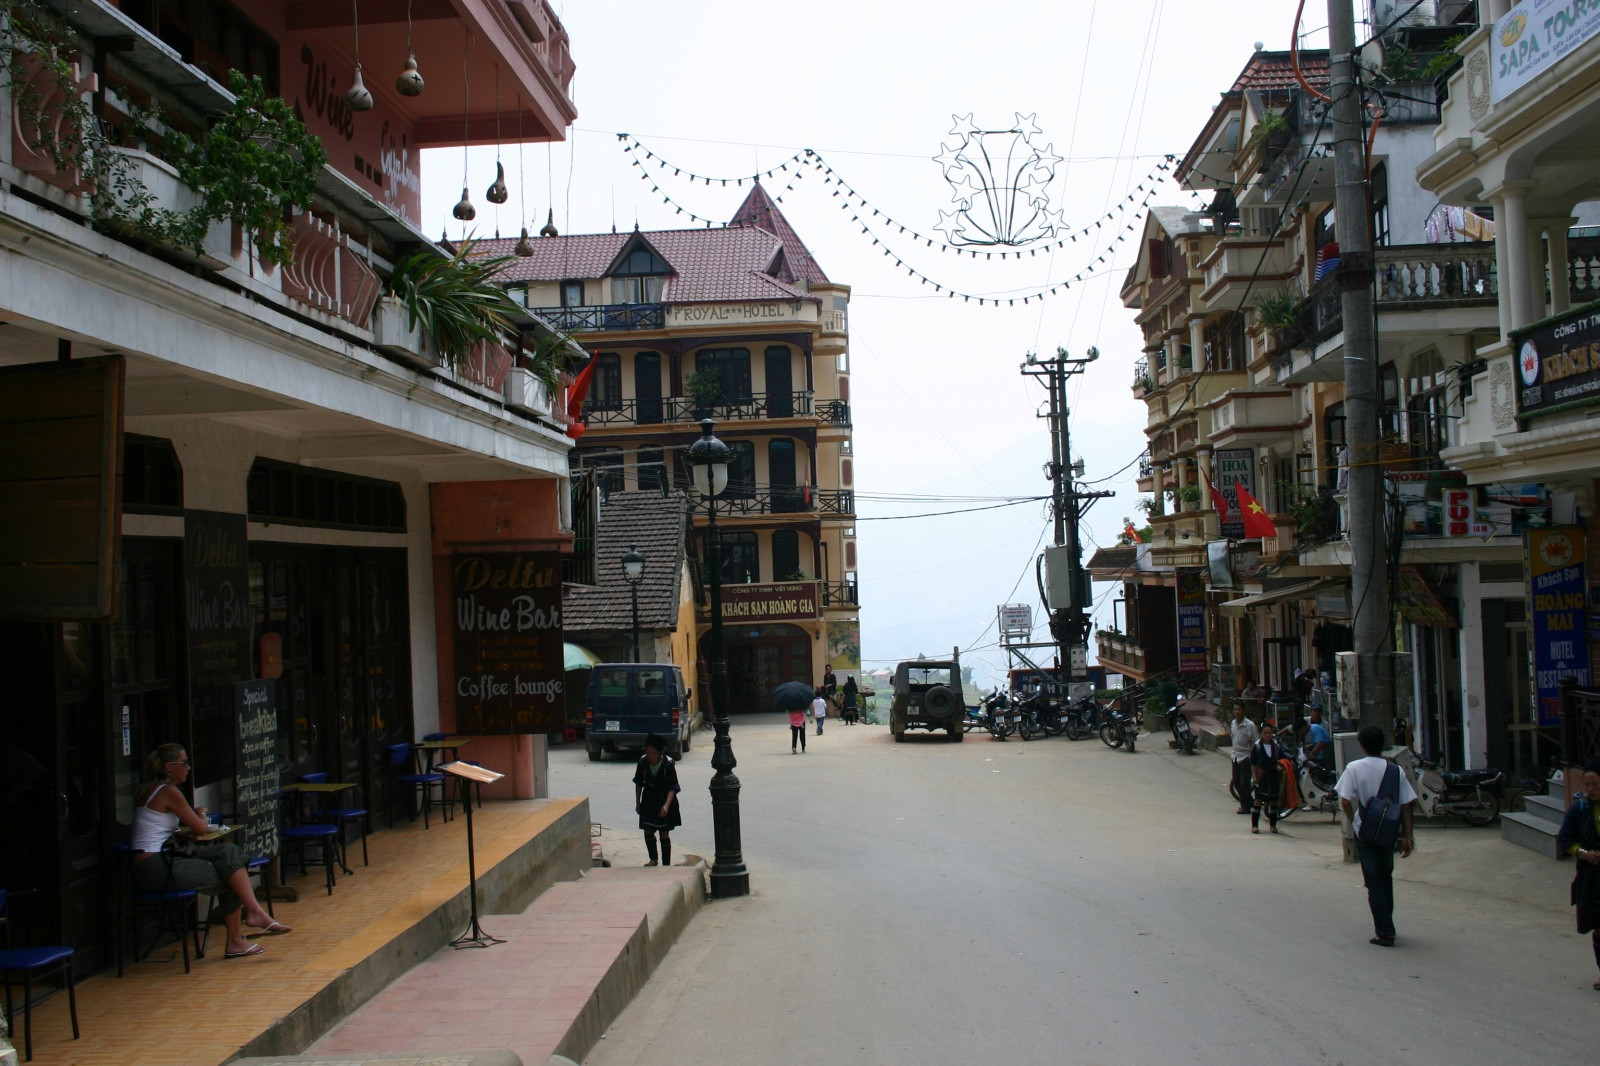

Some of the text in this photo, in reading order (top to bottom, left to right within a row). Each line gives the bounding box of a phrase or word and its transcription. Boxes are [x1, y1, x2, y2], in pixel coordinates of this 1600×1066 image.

[1499, 32, 1540, 79] SAPA
[300, 41, 354, 142] Wine
[684, 303, 784, 321] ROYAL HOTEL
[1554, 323, 1576, 339] CÔNG
[1578, 318, 1588, 331] TY
[1543, 344, 1590, 384] KHÁCH
[1222, 460, 1248, 471] HOA
[1448, 490, 1469, 536] PUB
[190, 524, 239, 568] Delta
[455, 557, 557, 591] Delta
[1537, 571, 1562, 589] Khách
[185, 575, 250, 632] Wine Bar
[721, 595, 815, 618] KHÁCH SẠN HOÀNG GIA
[1535, 588, 1584, 611] HOÀNG
[457, 594, 561, 632] Wine Bar
[1547, 614, 1573, 630] MAI
[1550, 640, 1575, 660] HOTEL
[1556, 661, 1568, 669] &
[243, 687, 268, 711] Special
[457, 674, 563, 703] Coffee lounge
[240, 706, 278, 739] breakfast
